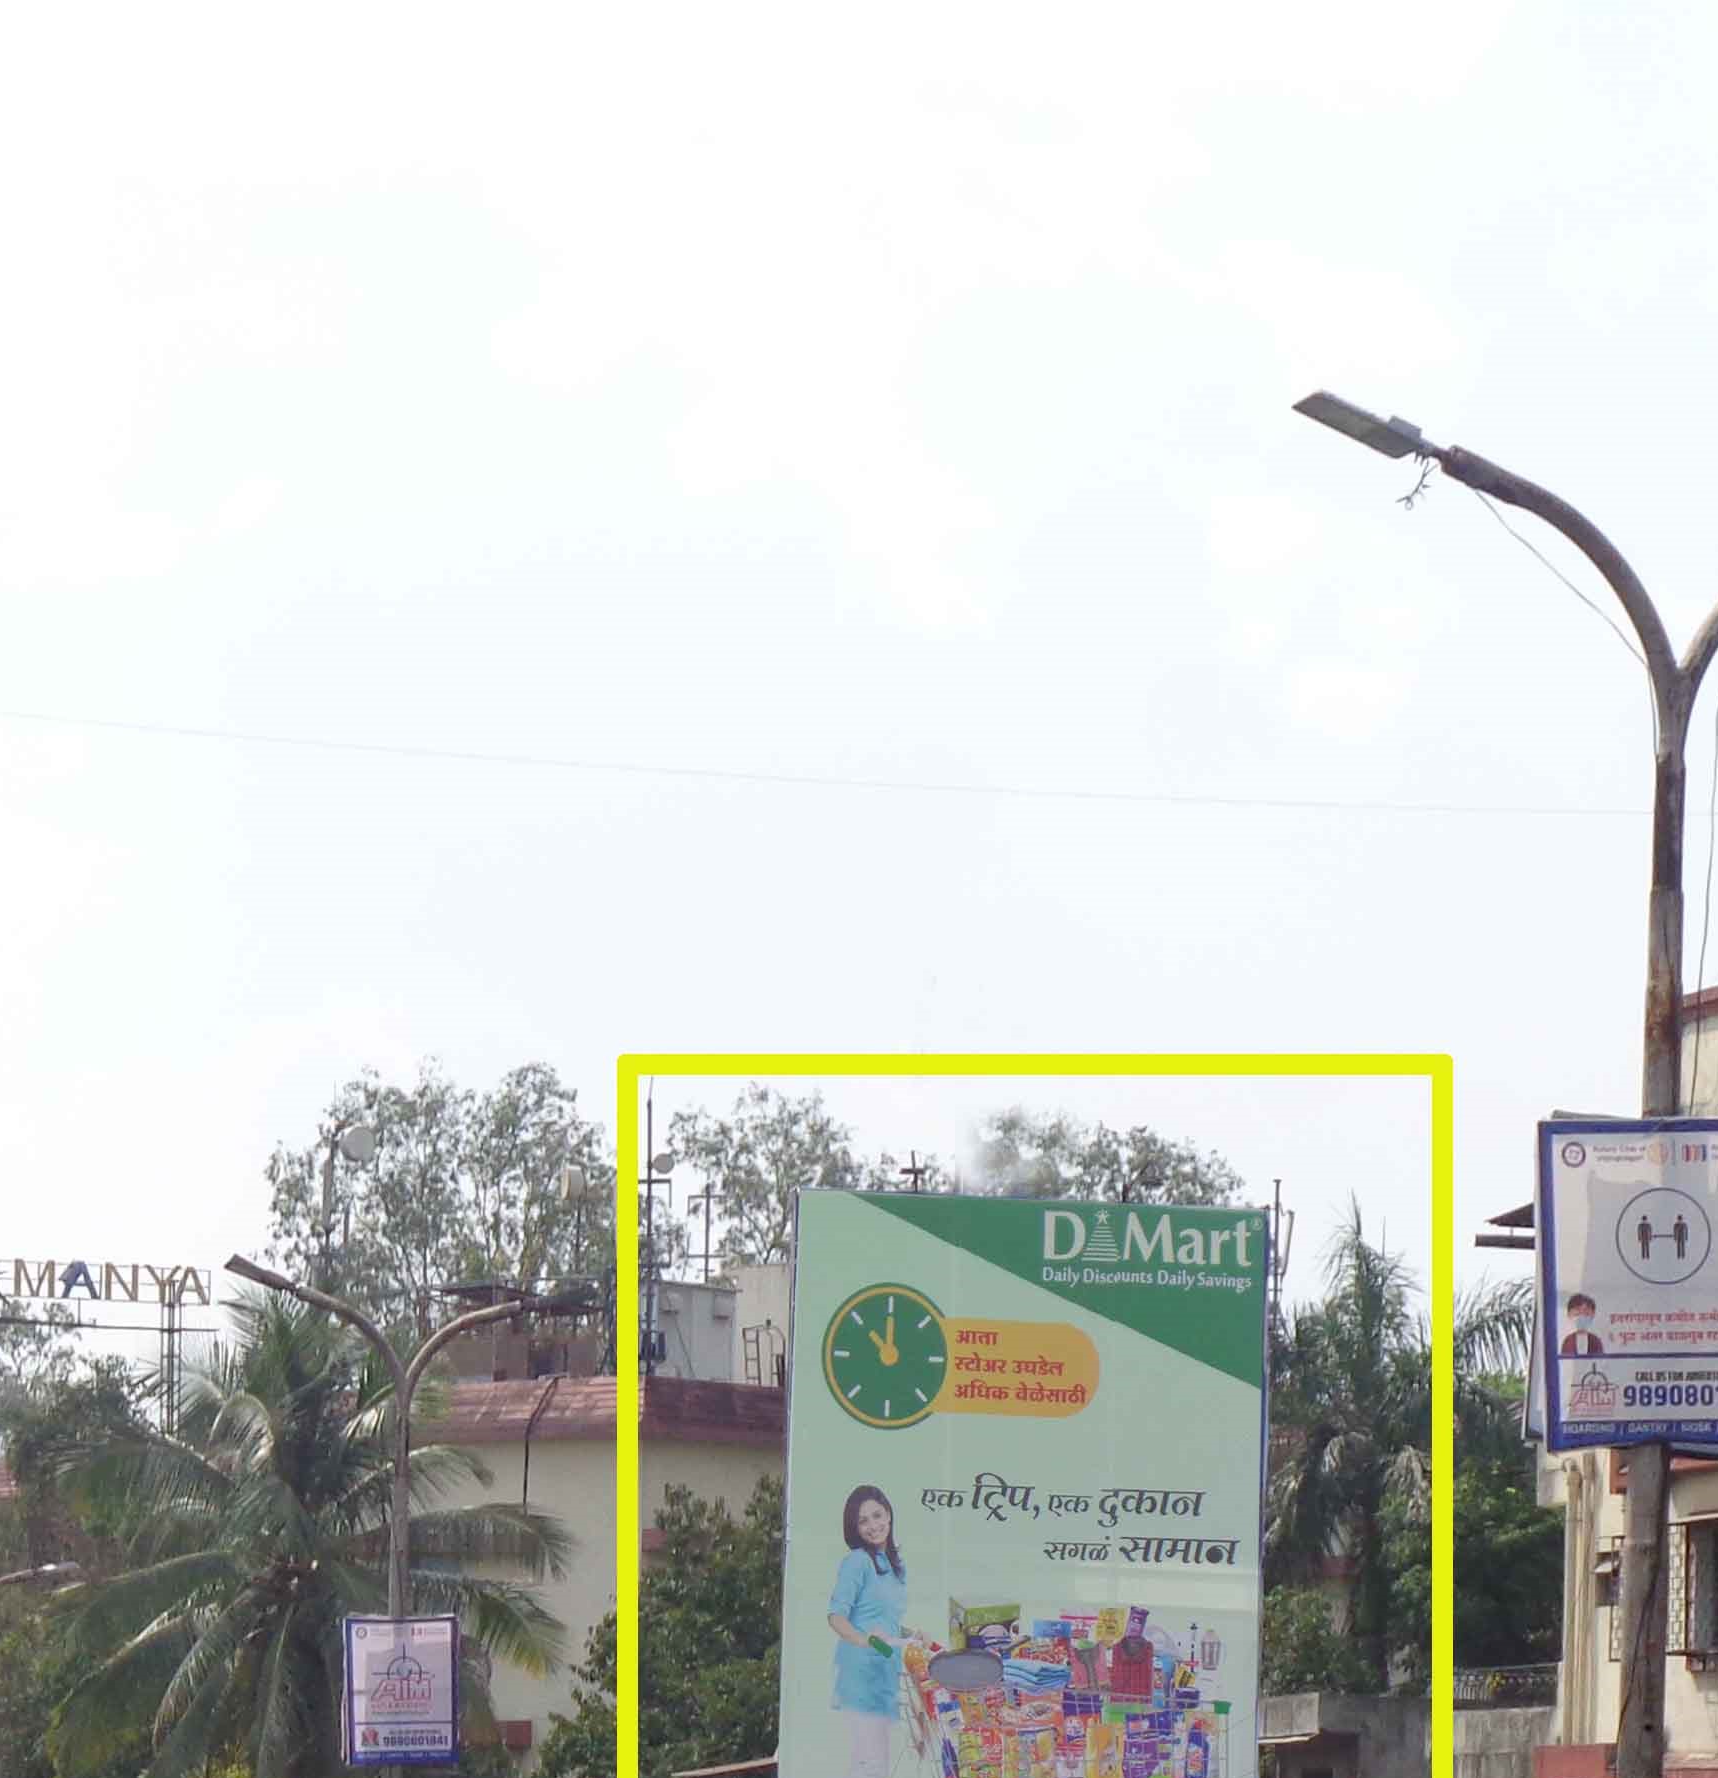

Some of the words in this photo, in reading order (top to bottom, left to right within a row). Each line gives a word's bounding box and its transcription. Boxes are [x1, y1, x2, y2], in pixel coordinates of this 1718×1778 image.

[1042, 1266, 1080, 1287] Daily
[1083, 1268, 1153, 1285] Discounts
[1157, 1269, 1197, 1291] Daily
[1198, 1271, 1252, 1293] Savings
[955, 1329, 999, 1346] आता
[954, 1378, 1011, 1400] अधिक
[920, 1488, 968, 1512] एक
[1047, 1493, 1094, 1517] एक
[1098, 1488, 1206, 1528] दुकान
[1042, 1535, 1112, 1562] सगळं
[1119, 1536, 1240, 1565] सामान
[371, 1675, 432, 1701] AIM
